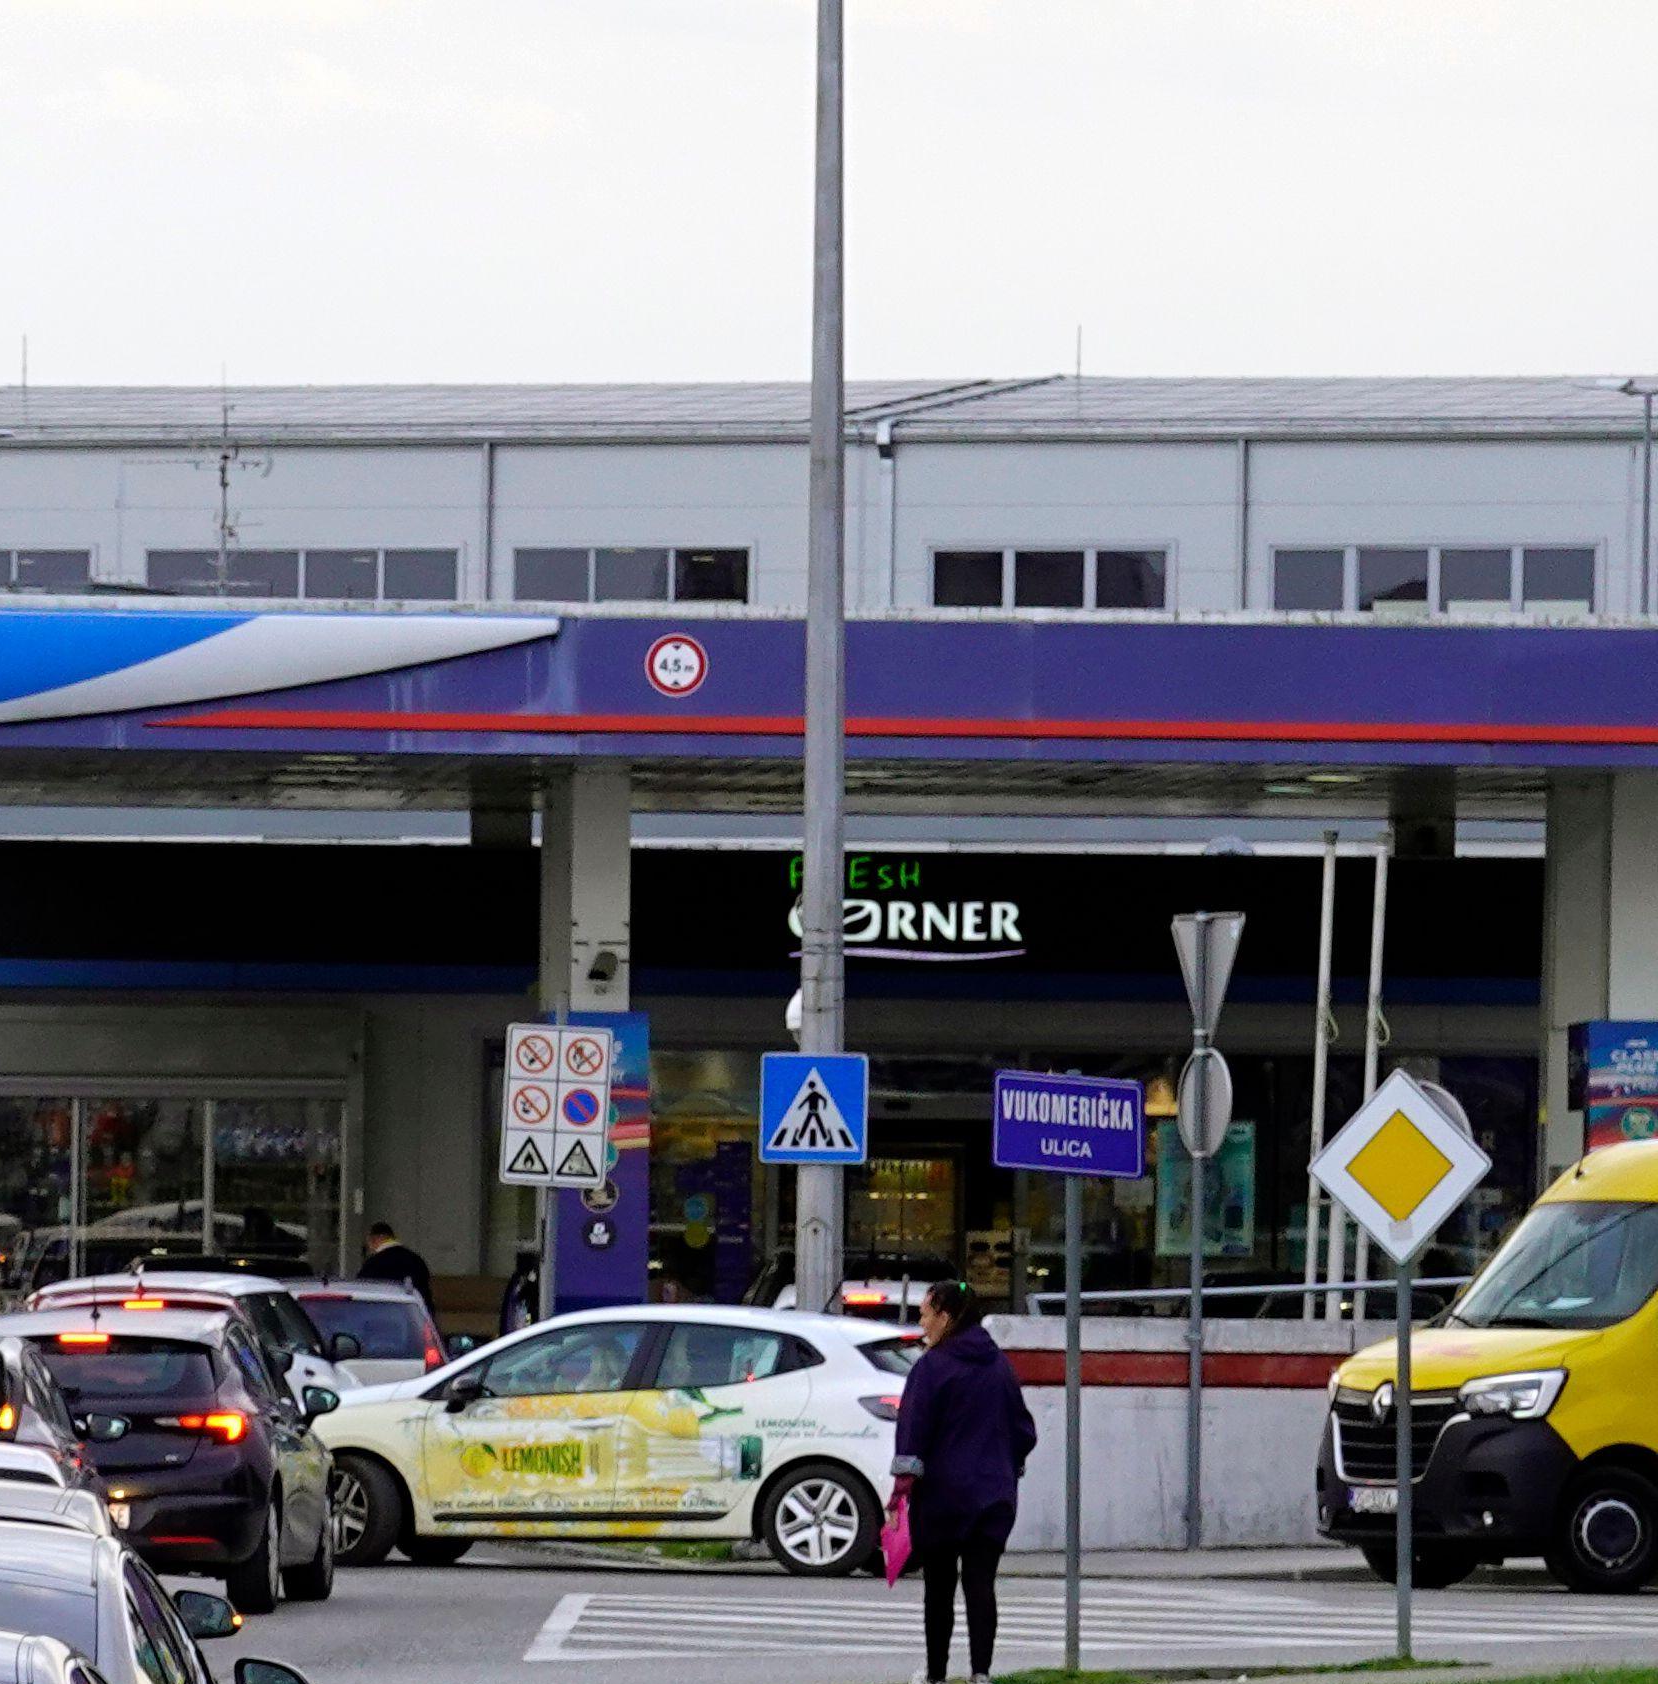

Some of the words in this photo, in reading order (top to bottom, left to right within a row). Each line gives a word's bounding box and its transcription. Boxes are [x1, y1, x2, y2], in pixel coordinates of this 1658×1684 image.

[790, 856, 921, 890] FESH
[788, 899, 1023, 942] ORNER
[1001, 1089, 1133, 1131] VUKOMERIČKA
[1040, 1137, 1093, 1158] ULICA
